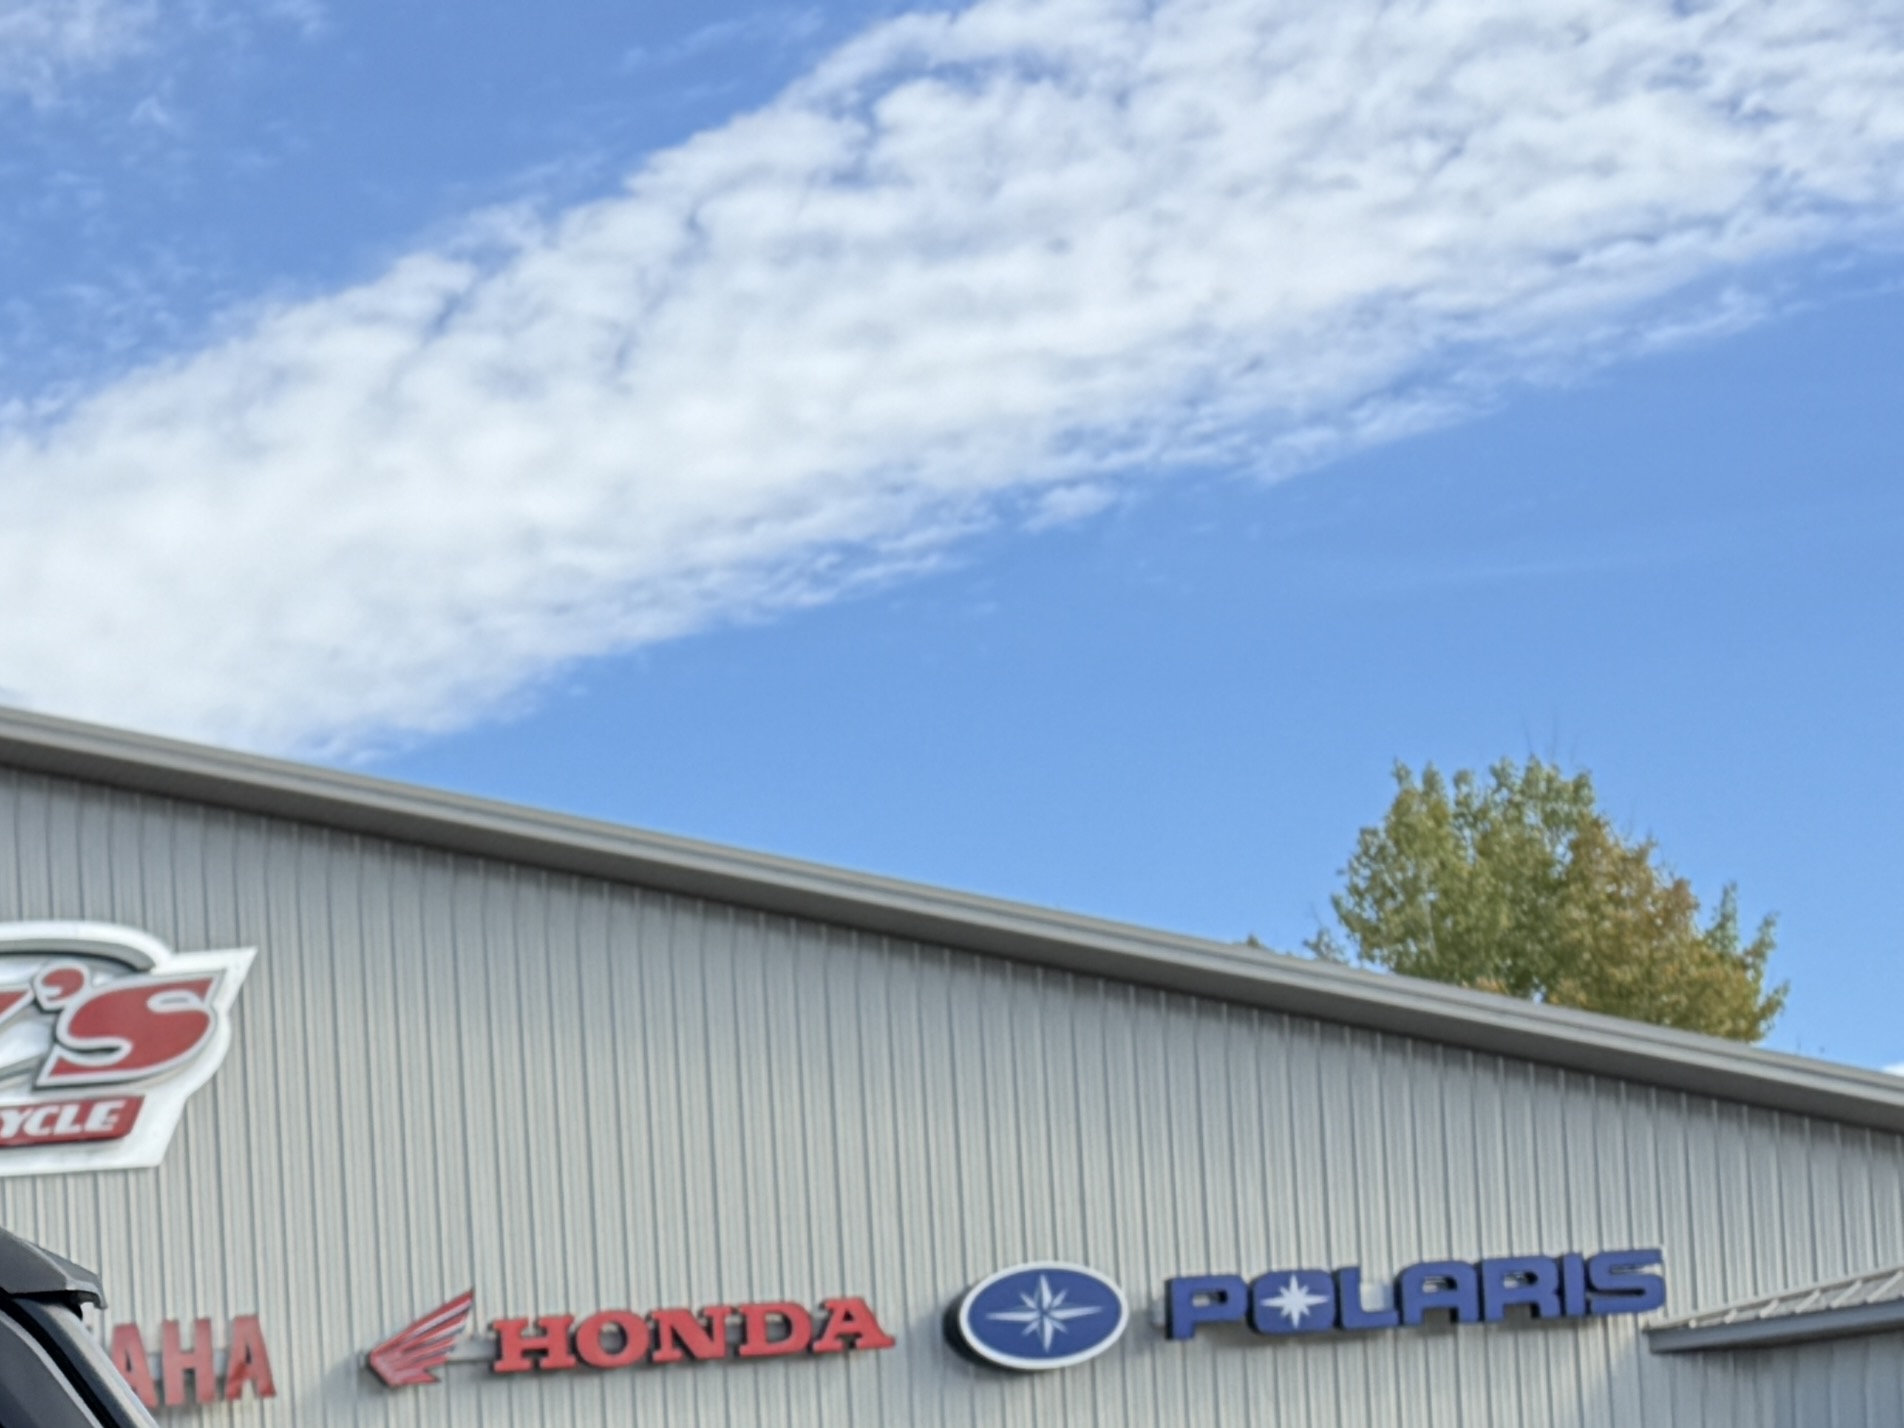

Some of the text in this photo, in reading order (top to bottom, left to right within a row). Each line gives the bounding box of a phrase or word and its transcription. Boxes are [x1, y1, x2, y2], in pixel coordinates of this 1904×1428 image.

[490, 1295, 896, 1377] HONDA
[1164, 1248, 1666, 1341] POLARIS
[110, 1314, 277, 1410] AHA
